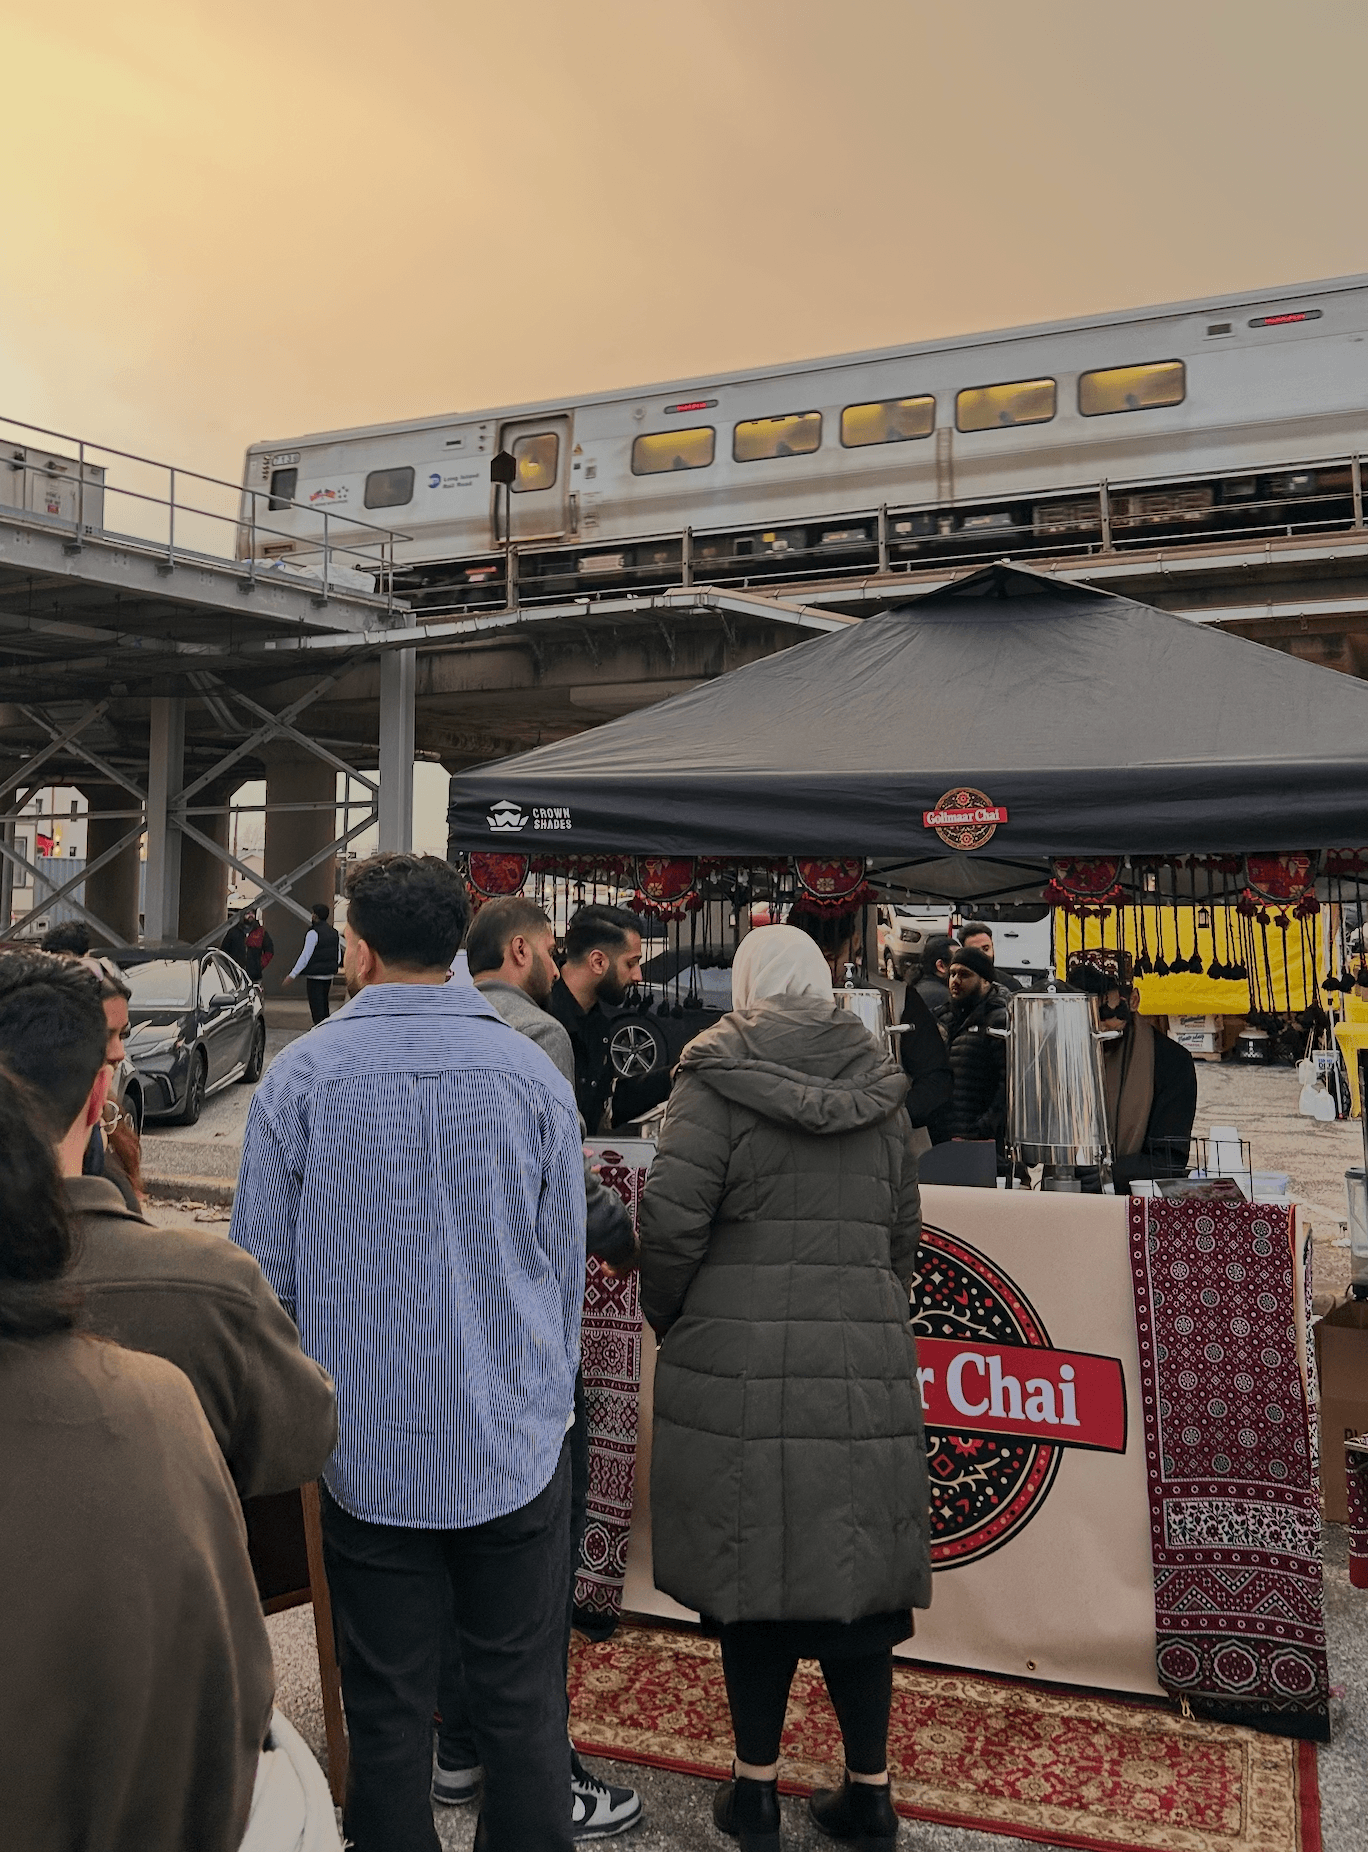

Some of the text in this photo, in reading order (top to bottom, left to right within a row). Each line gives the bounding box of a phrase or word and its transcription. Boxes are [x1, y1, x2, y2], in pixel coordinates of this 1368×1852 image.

[532, 807, 571, 819] CROWN
[926, 808, 1000, 825] Golimaar Chai
[533, 819, 572, 830] SHADES
[946, 1352, 1081, 1427] Chai
